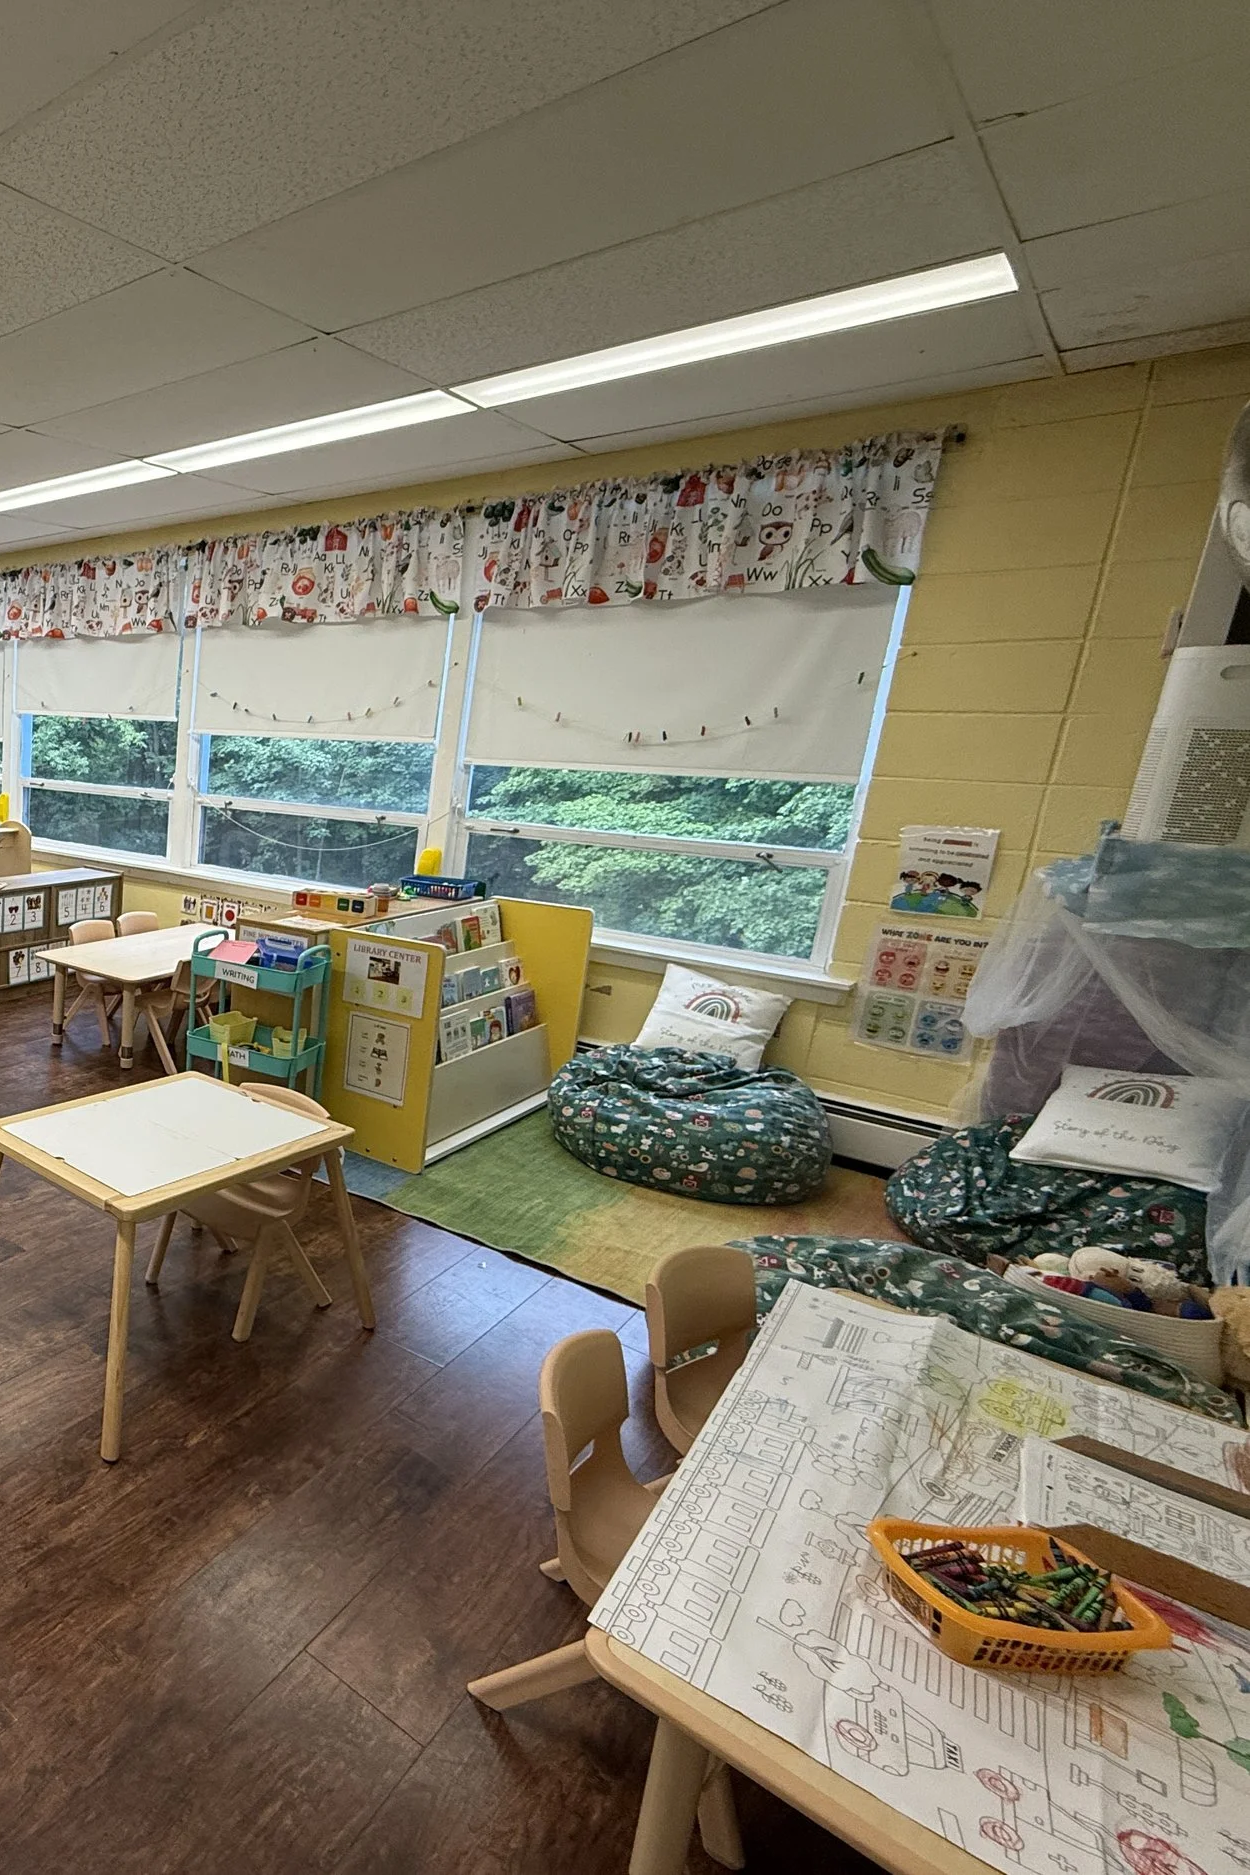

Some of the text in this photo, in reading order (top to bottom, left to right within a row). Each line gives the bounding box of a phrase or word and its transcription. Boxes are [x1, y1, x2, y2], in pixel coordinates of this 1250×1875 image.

[761, 502, 784, 517] Oo
[809, 517, 833, 537] Pp
[573, 541, 590, 554] Pp
[313, 551, 328, 562] Aa
[746, 566, 779, 582] Ww
[417, 589, 430, 602] Zz
[570, 584, 588, 598] Xx
[63, 902, 106, 918] 5 4 6
[9, 914, 17, 926] 2
[30, 911, 37, 923] 3
[934, 935, 953, 944] ARE
[953, 938, 973, 947] YOU
[972, 941, 990, 949] IN?
[353, 943, 422, 964] LIBRARY CENTER
[15, 961, 42, 977] 7 8
[221, 967, 256, 984] WRITING
[1111, 1129, 1138, 1142] the
[945, 1742, 961, 1769] TAXI
